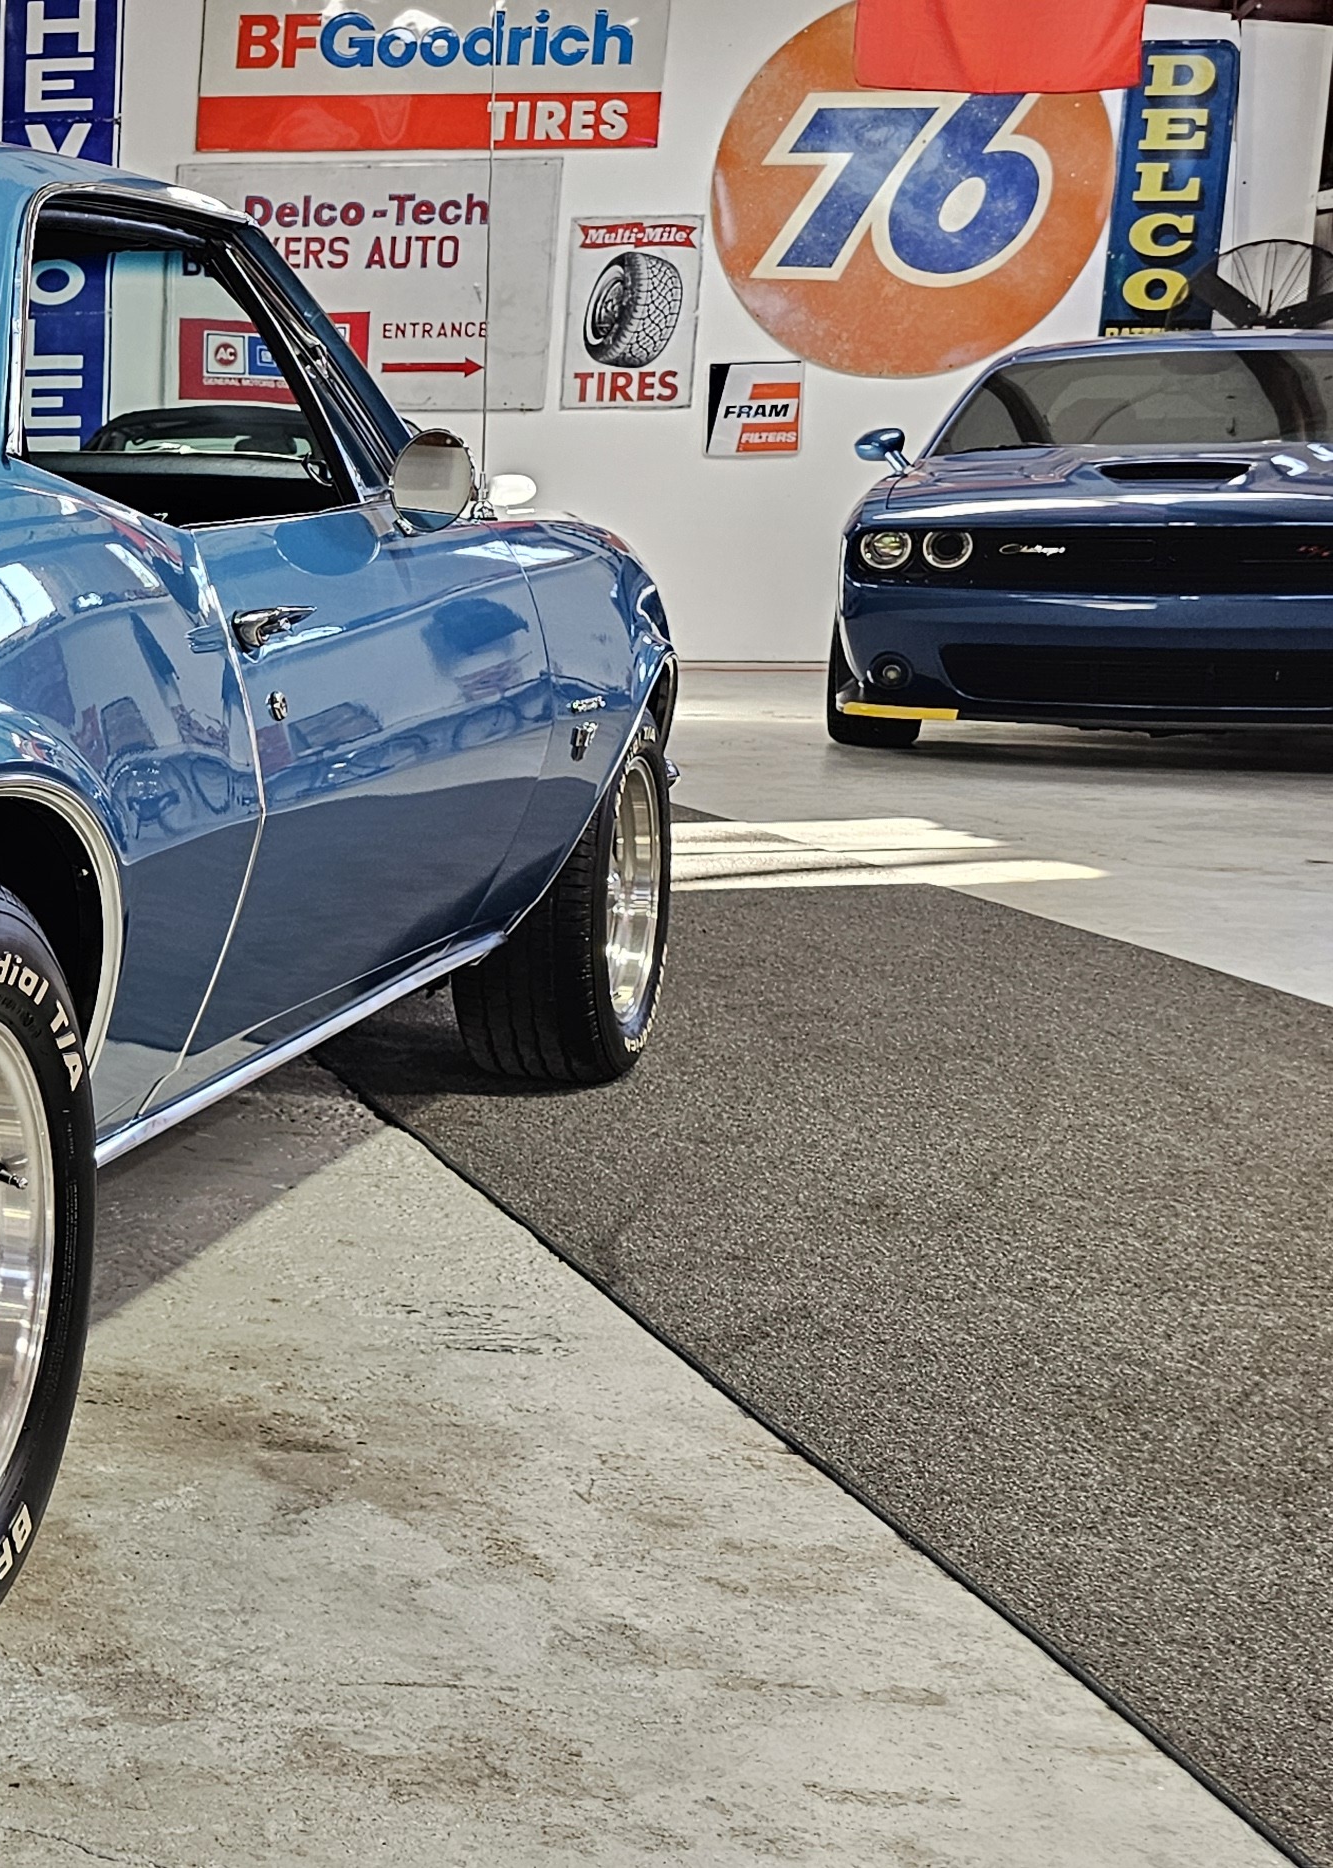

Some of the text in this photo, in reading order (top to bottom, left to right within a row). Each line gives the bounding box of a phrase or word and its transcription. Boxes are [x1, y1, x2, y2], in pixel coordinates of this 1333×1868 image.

[236, 9, 633, 69] BFGoodrich
[487, 99, 629, 141] TIRES
[749, 93, 1053, 288] 76
[1122, 55, 1216, 311] DELCO
[585, 226, 687, 243] Multi-Mile
[365, 235, 460, 269] AUTO
[383, 321, 488, 339] ENTRANCE
[215, 347, 235, 361] AC
[573, 370, 679, 402] TIRES
[723, 404, 790, 419] FRAM
[740, 431, 798, 443] FILTERS
